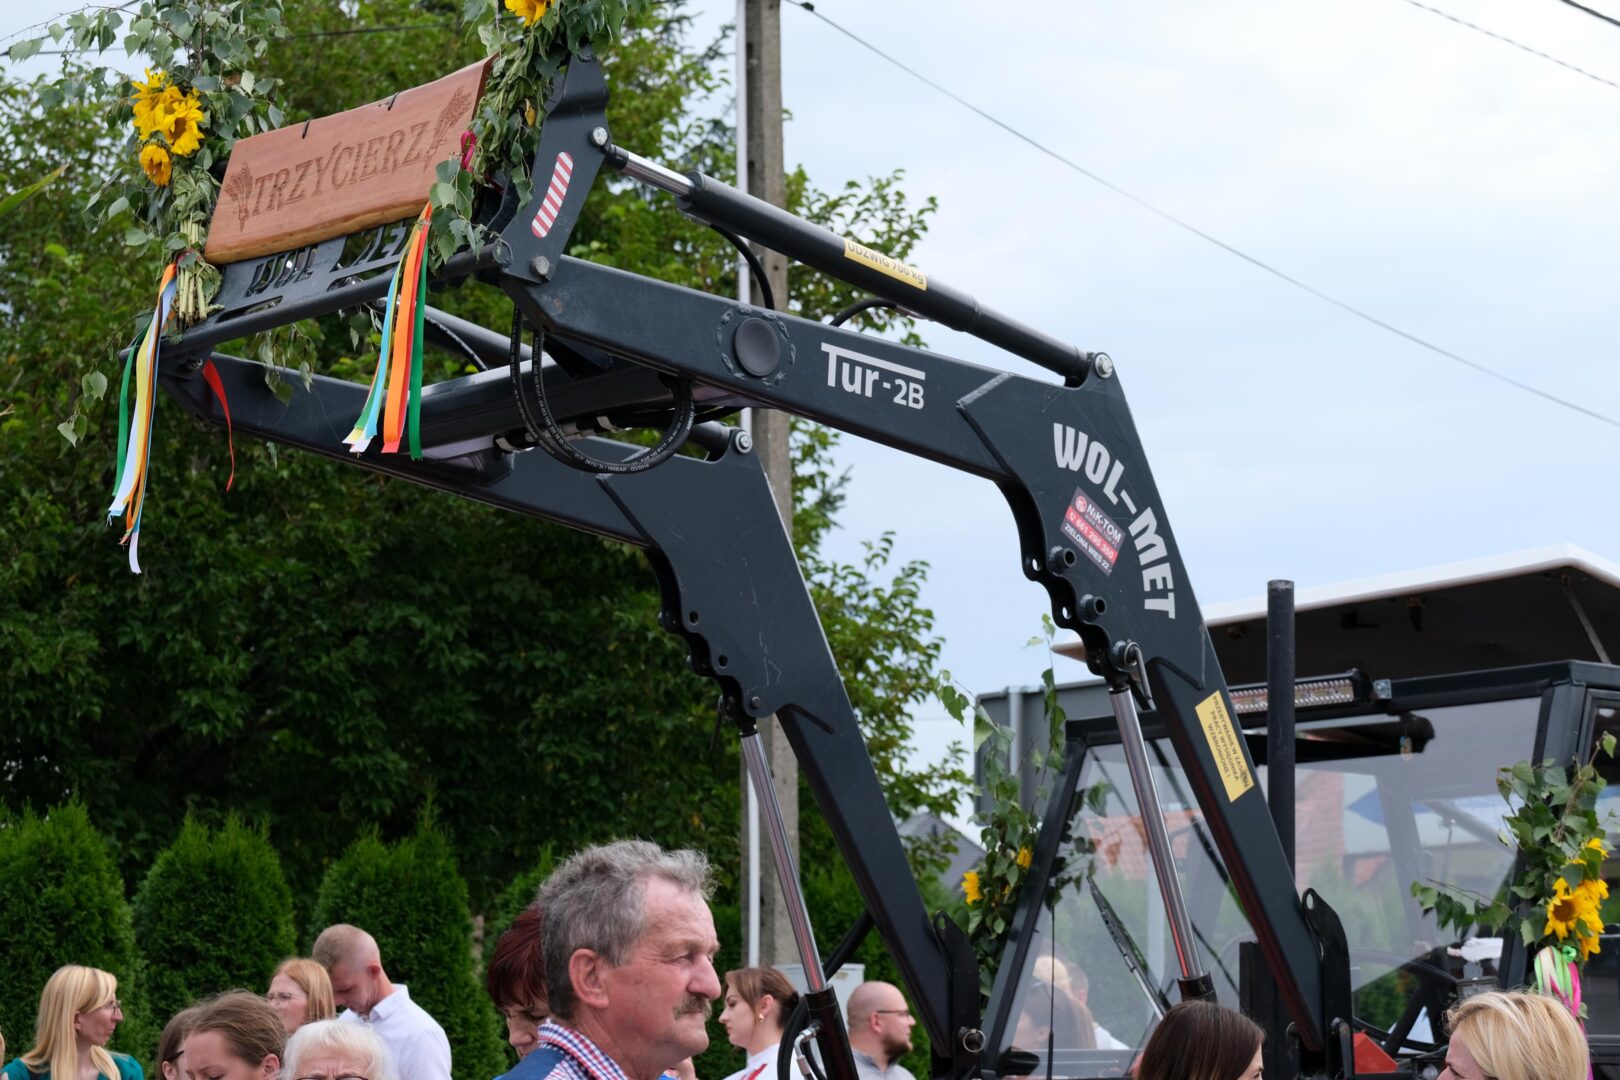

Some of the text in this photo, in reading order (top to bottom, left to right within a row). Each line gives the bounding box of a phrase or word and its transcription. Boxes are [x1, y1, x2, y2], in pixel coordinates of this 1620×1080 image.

[251, 120, 430, 216] TRZYCIERZ
[821, 342, 926, 410] Tur-2B
[1053, 422, 1176, 619] WOL-MET
[1064, 523, 1088, 551] ZIELONA
